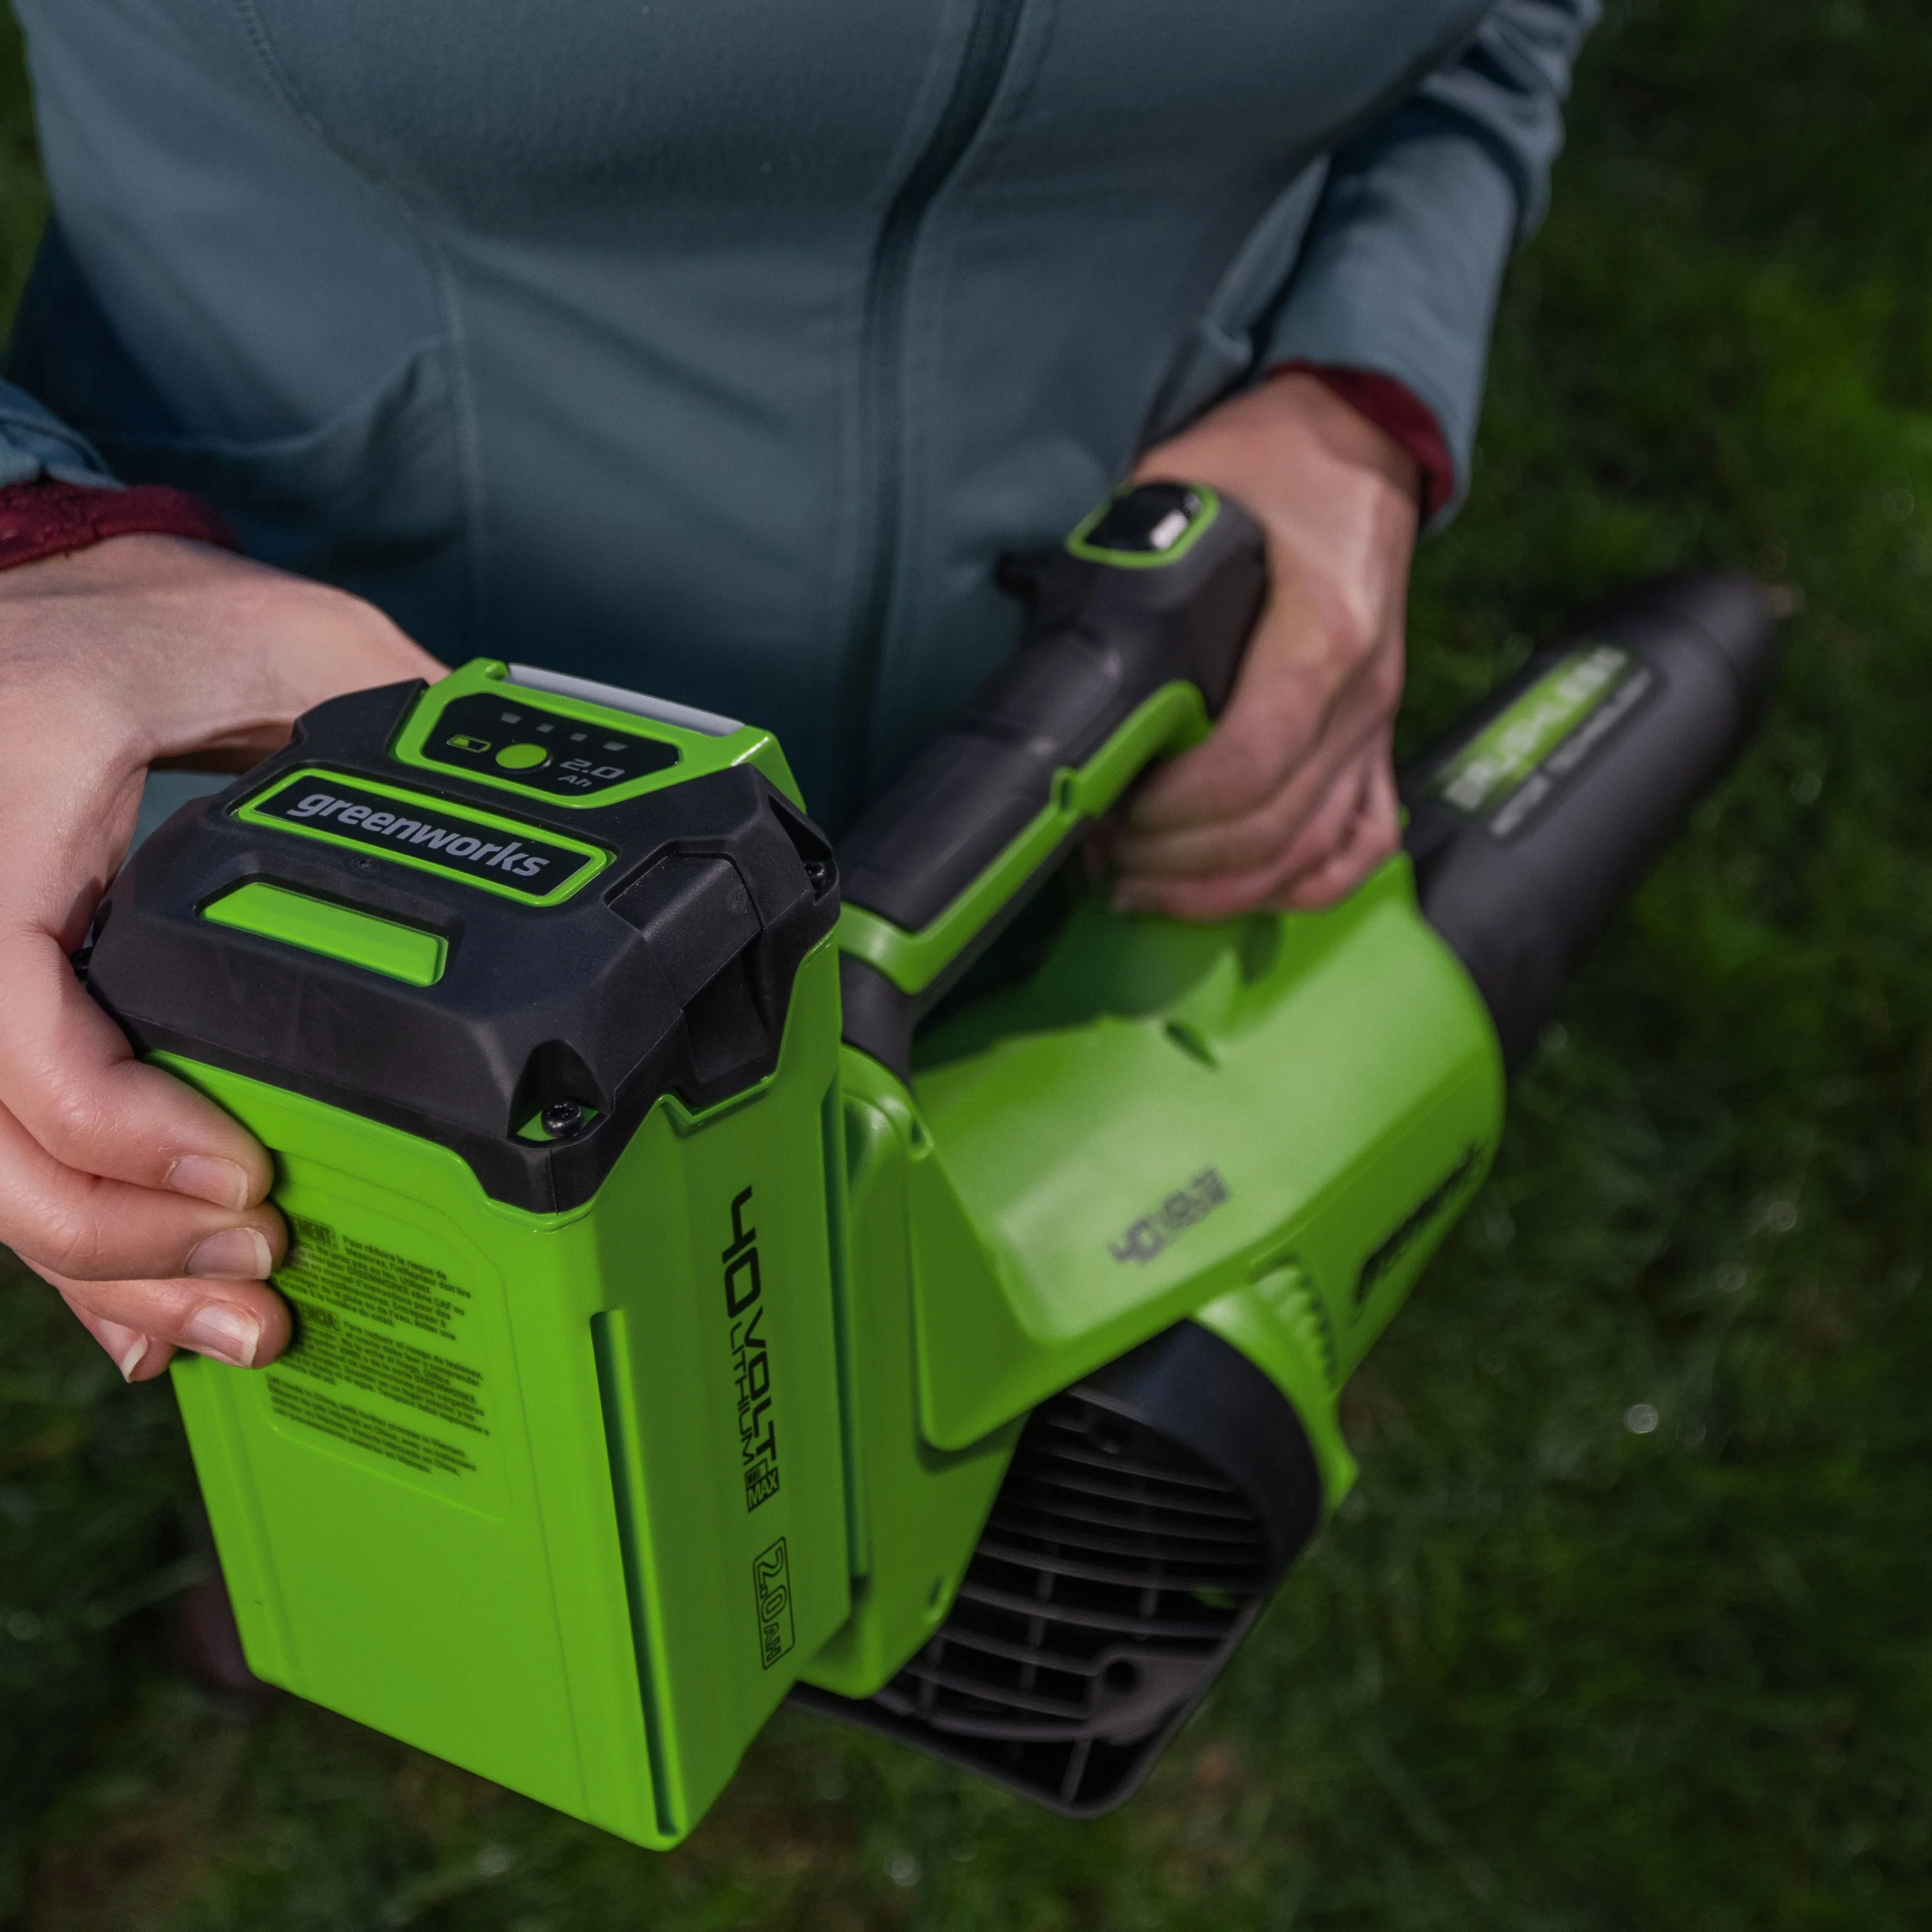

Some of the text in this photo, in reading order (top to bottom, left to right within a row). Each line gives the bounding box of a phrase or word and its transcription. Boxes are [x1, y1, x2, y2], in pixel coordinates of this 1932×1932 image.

[557, 775, 592, 787] Ah
[559, 758, 626, 779] 2.0
[287, 794, 550, 877] greenworks
[730, 1321, 755, 1467] LITHIUM
[748, 1472, 779, 1509] MAX
